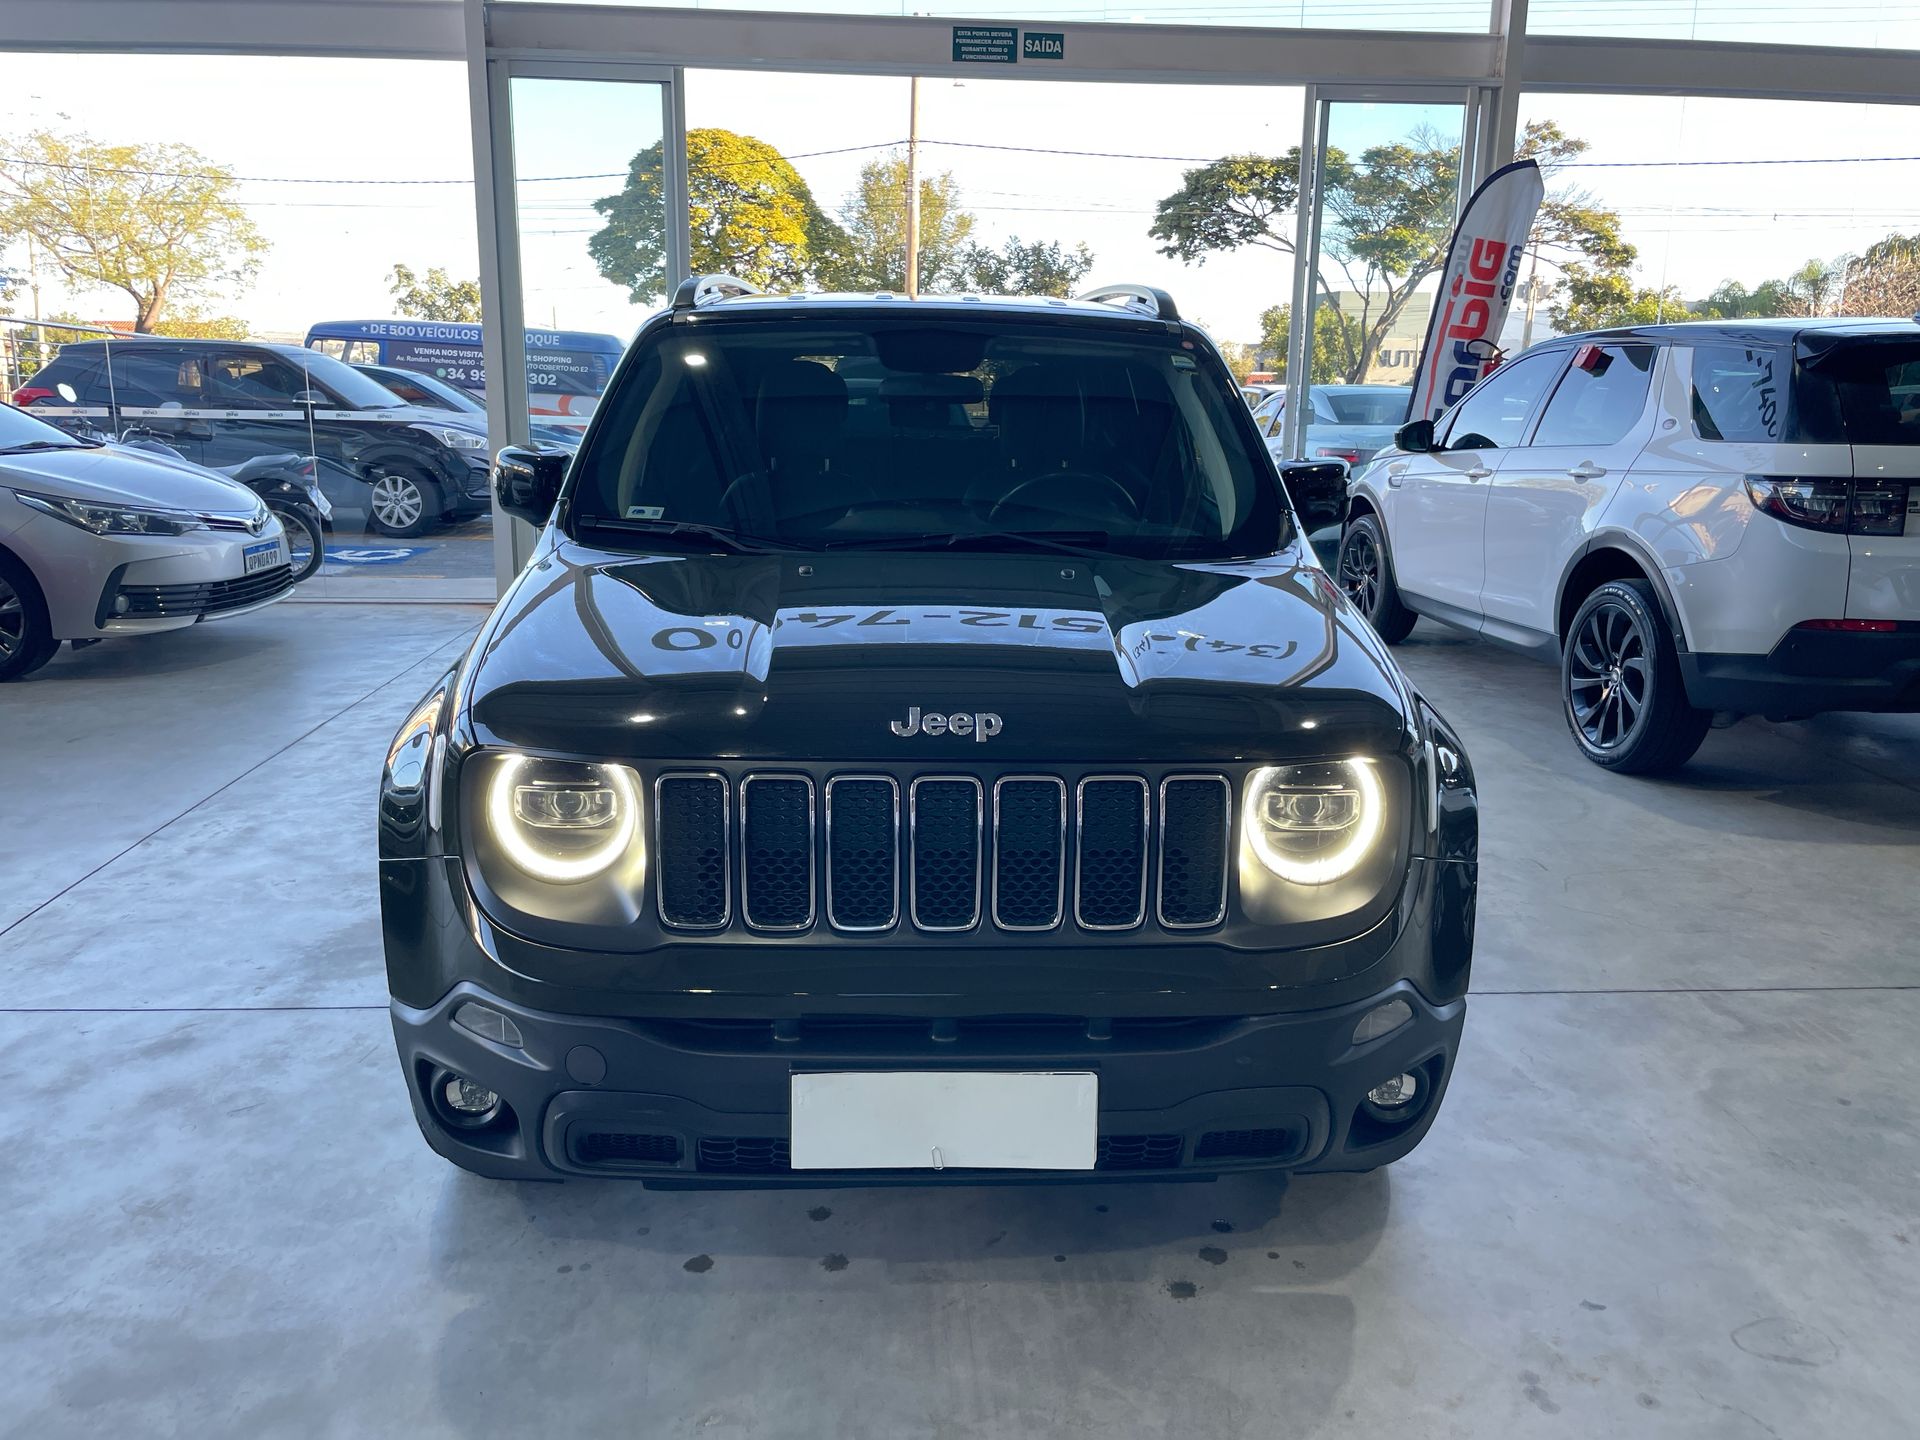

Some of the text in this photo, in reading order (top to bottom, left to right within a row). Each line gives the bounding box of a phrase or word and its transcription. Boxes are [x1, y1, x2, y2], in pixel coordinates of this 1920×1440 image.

[1025, 37, 1062, 53] SAÍDA
[370, 324, 387, 334] DE
[389, 325, 416, 336] 500
[417, 325, 479, 340] VEÍCULOS
[414, 347, 441, 356] VENHA
[441, 348, 458, 357] NOS
[532, 355, 572, 364] SHOPPING
[447, 367, 466, 380] 34
[539, 364, 569, 372] COBERTO
[890, 706, 1003, 743] Jeep
